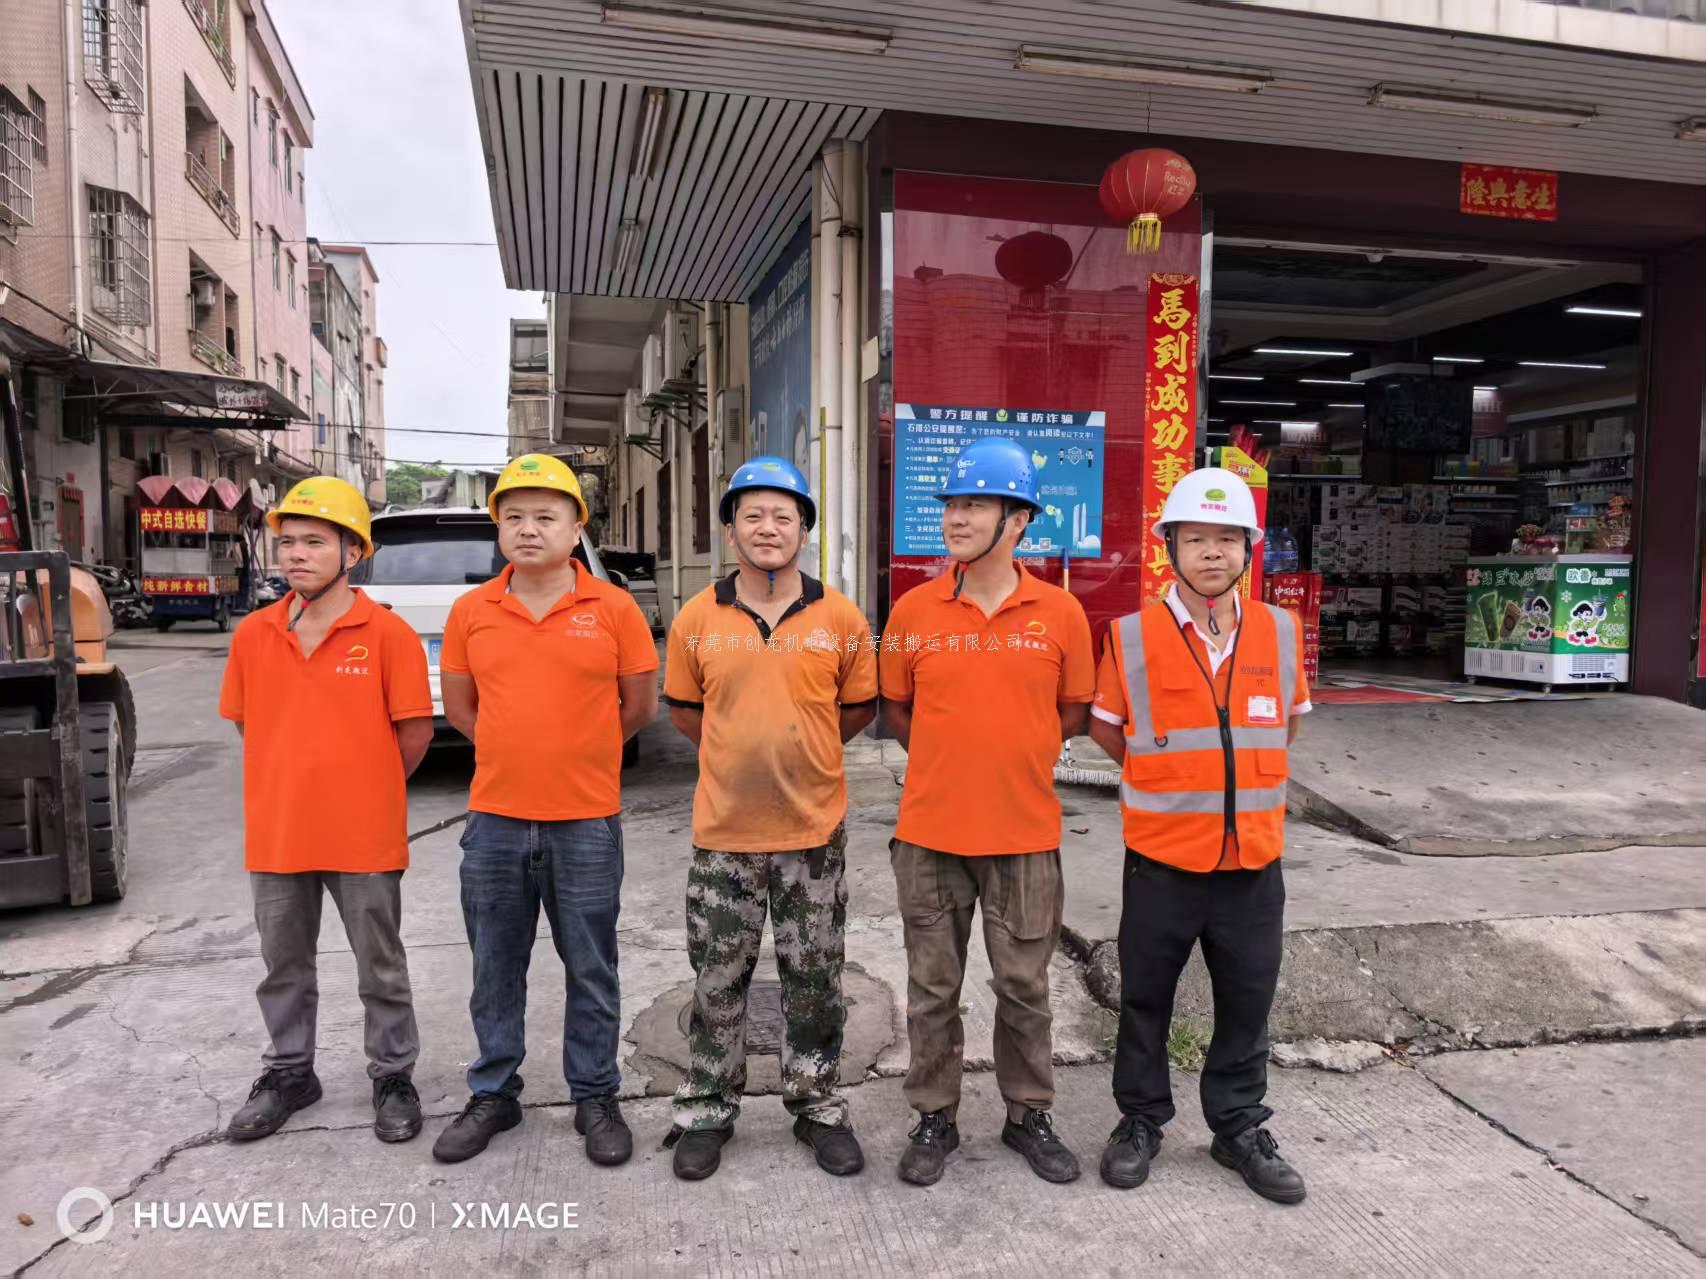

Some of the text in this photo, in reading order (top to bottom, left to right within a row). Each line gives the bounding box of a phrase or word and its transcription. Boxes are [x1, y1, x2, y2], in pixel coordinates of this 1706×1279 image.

[929, 408, 1074, 424] 警方提醒 谨防诈骗
[141, 509, 207, 530] 中式自选快餐
